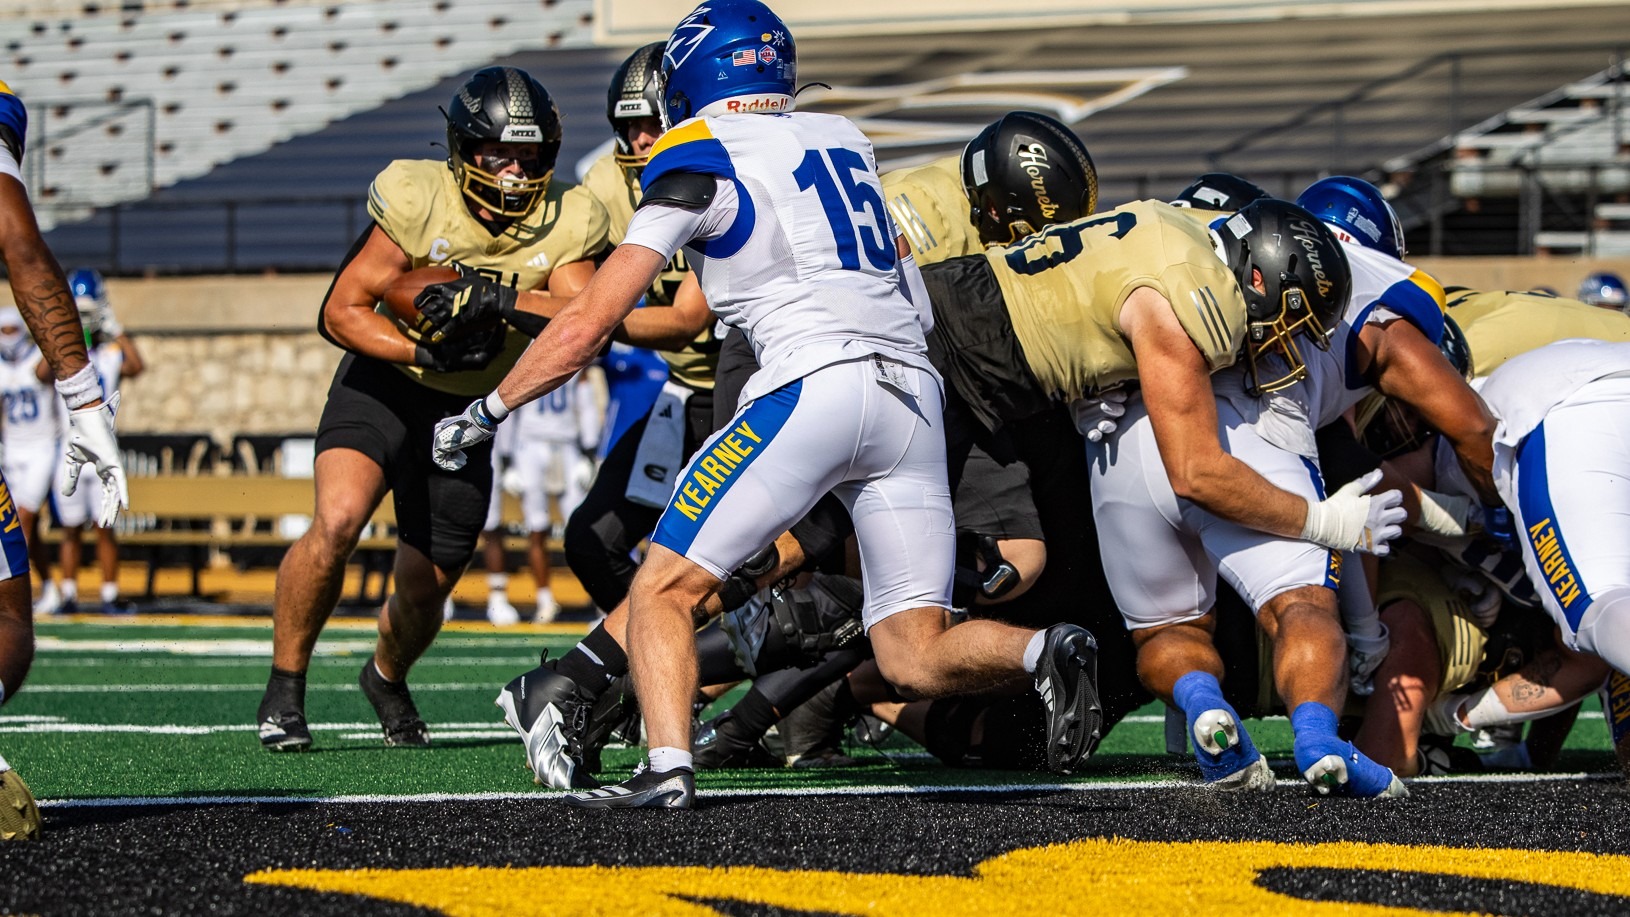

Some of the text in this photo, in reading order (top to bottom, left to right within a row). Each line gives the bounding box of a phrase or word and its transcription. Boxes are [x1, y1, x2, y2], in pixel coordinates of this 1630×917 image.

[727, 97, 789, 113] Riddell
[792, 147, 896, 271] 15
[1017, 143, 1060, 219] Hornets
[429, 238, 450, 261] C
[1005, 211, 1137, 276] 6
[1288, 219, 1334, 298] Hornets
[674, 420, 762, 522] KEARNEY
[1529, 517, 1581, 609] KEARNEY
